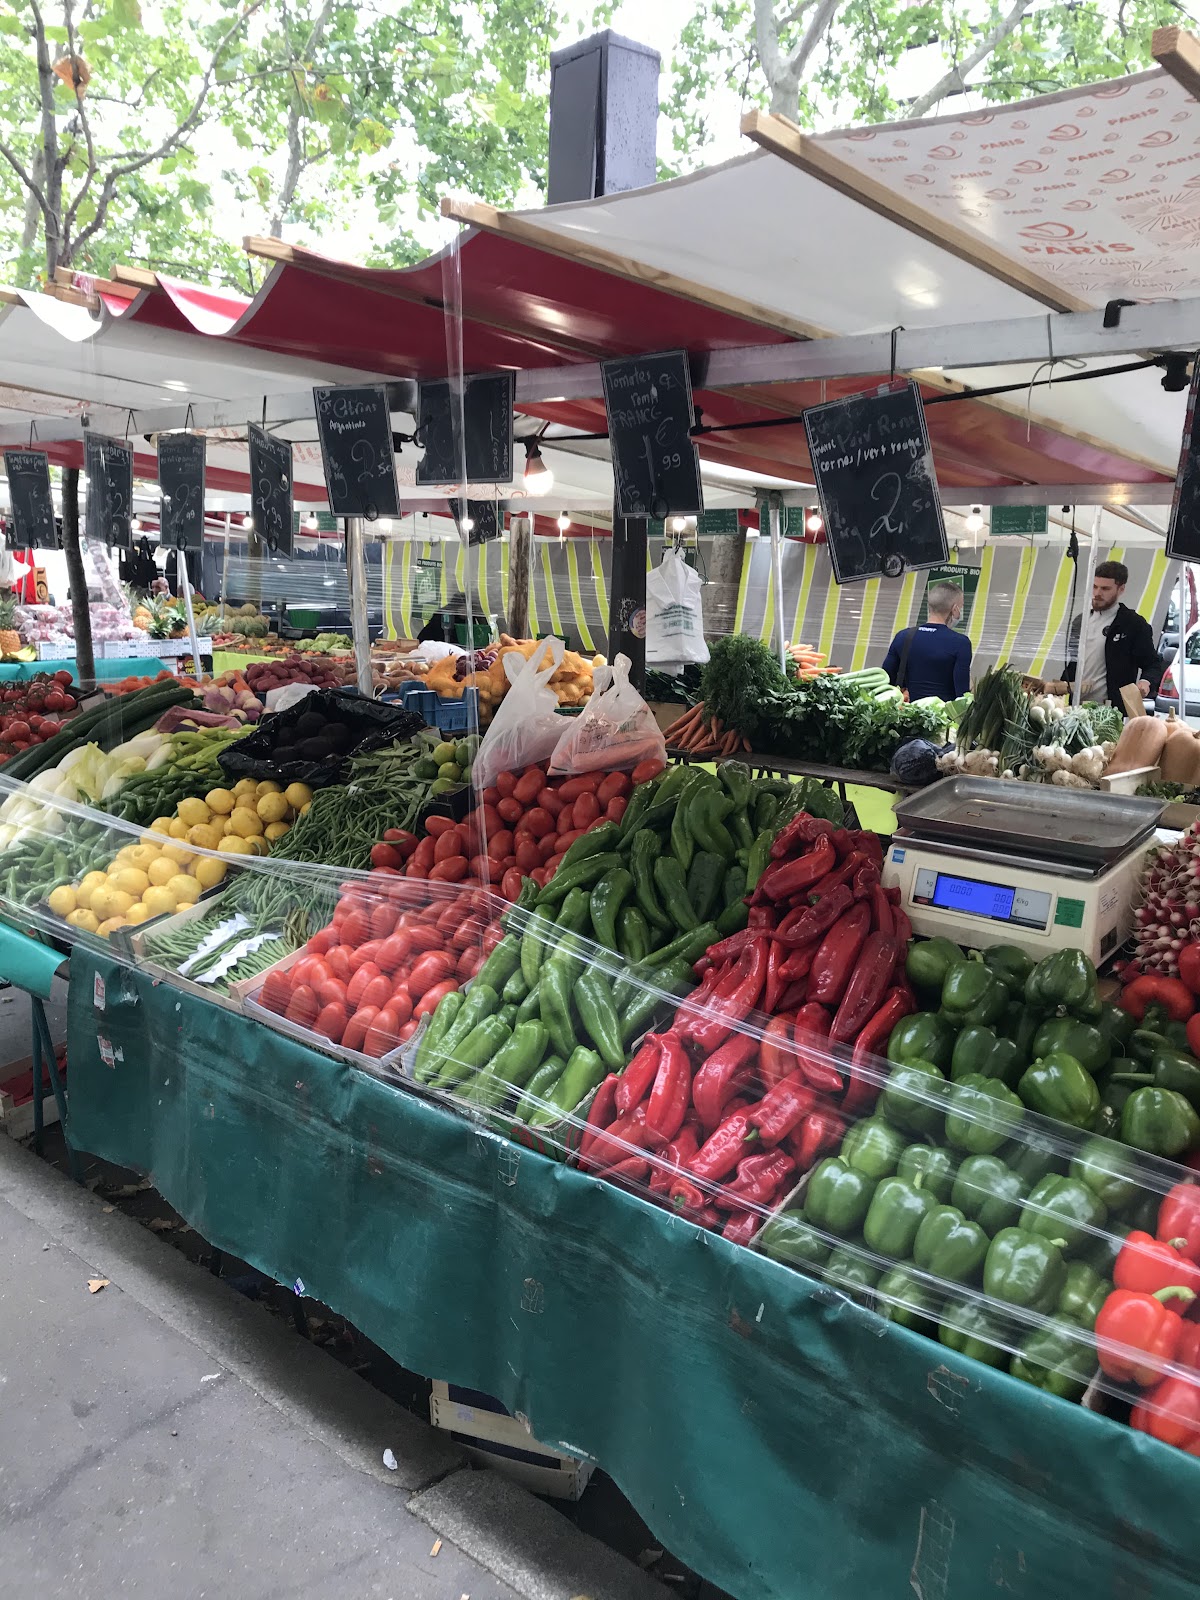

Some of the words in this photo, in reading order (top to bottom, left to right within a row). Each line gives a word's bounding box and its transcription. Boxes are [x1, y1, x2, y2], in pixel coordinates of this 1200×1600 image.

[1107, 107, 1160, 126] PARIS
[979, 138, 1025, 150] PARIS
[868, 155, 908, 163] PARIS
[1067, 148, 1115, 162] PARIS
[950, 170, 992, 180] PARIS
[1033, 182, 1077, 192] PARIS
[1115, 188, 1160, 201] PARIS
[1019, 243, 1135, 254] PARIS
[607, 367, 650, 390] Tomates
[610, 408, 662, 429] FRANCE
[940, 565, 968, 576] PRODUITS
[969, 568, 980, 576] BIO
[926, 880, 934, 888] kg
